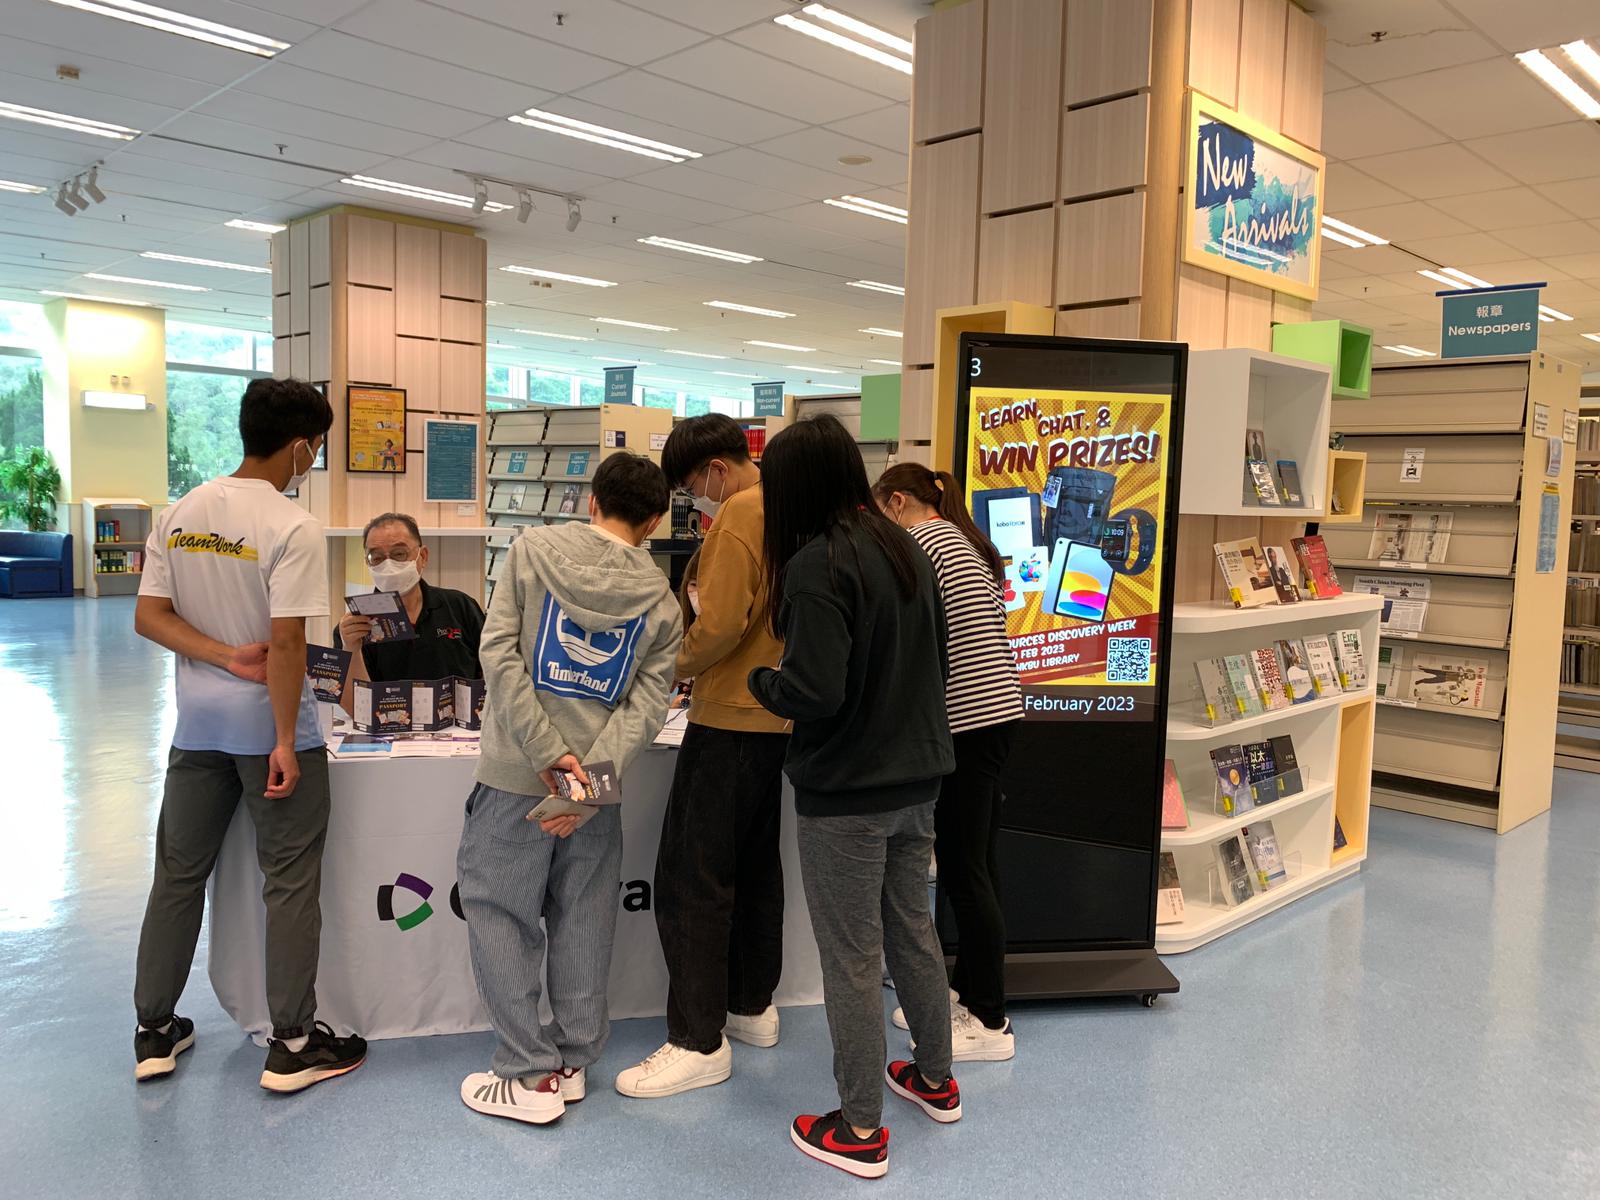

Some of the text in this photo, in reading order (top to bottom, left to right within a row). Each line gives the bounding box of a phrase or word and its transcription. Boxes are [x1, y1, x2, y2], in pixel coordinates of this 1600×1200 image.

[1203, 132, 1248, 196] New
[1221, 186, 1309, 256] Arrivals
[1475, 304, 1503, 318] 報章
[1448, 322, 1531, 337] Newspapers
[979, 398, 1112, 437] LEARN, CHAT, &
[979, 430, 1161, 476] WIN PRIZES!
[170, 527, 245, 555] TeamWork
[1048, 624, 1105, 643] DISCOVERY
[1107, 619, 1137, 633] WEEK
[1341, 631, 1358, 643] Excel
[1016, 653, 1080, 671] HKBU LIBRARY
[1020, 648, 1038, 659] FEB
[1041, 644, 1065, 656] 2023
[1024, 695, 1135, 714] February 2023
